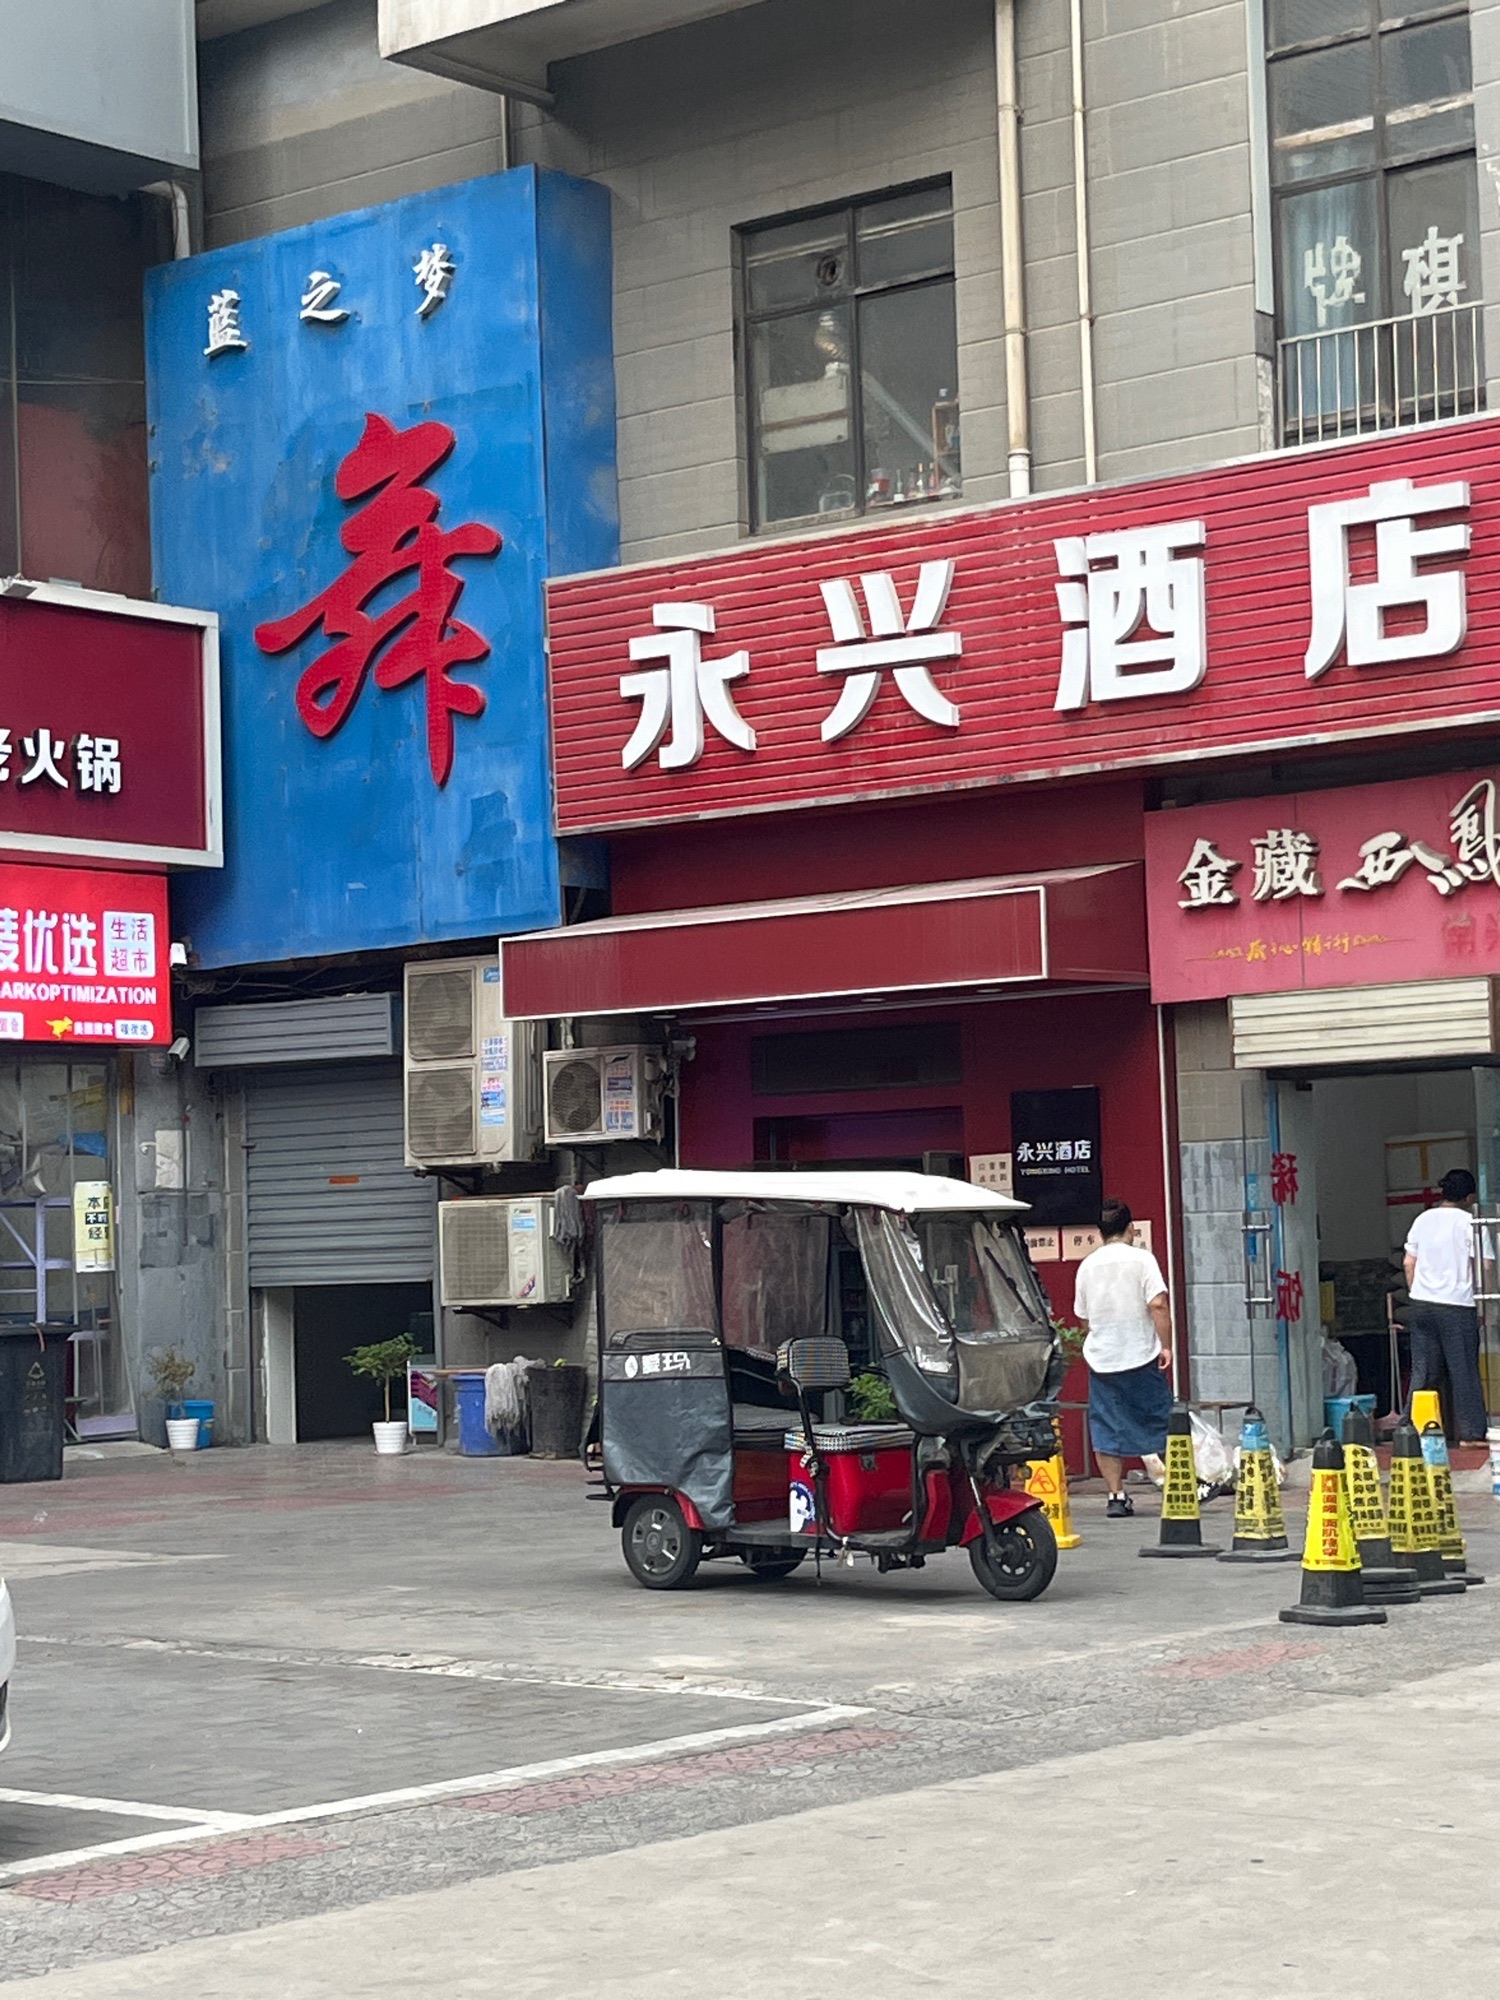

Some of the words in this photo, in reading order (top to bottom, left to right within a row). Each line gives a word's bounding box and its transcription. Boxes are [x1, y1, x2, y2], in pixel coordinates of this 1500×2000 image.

[204, 243, 457, 358] 蓝之梦
[619, 477, 1472, 770] 永兴酒店
[111, 917, 148, 942] 生活
[111, 947, 149, 973] 超市
[1016, 1139, 1092, 1163] 永兴酒店
[1064, 1165, 1090, 1175] HOTEL
